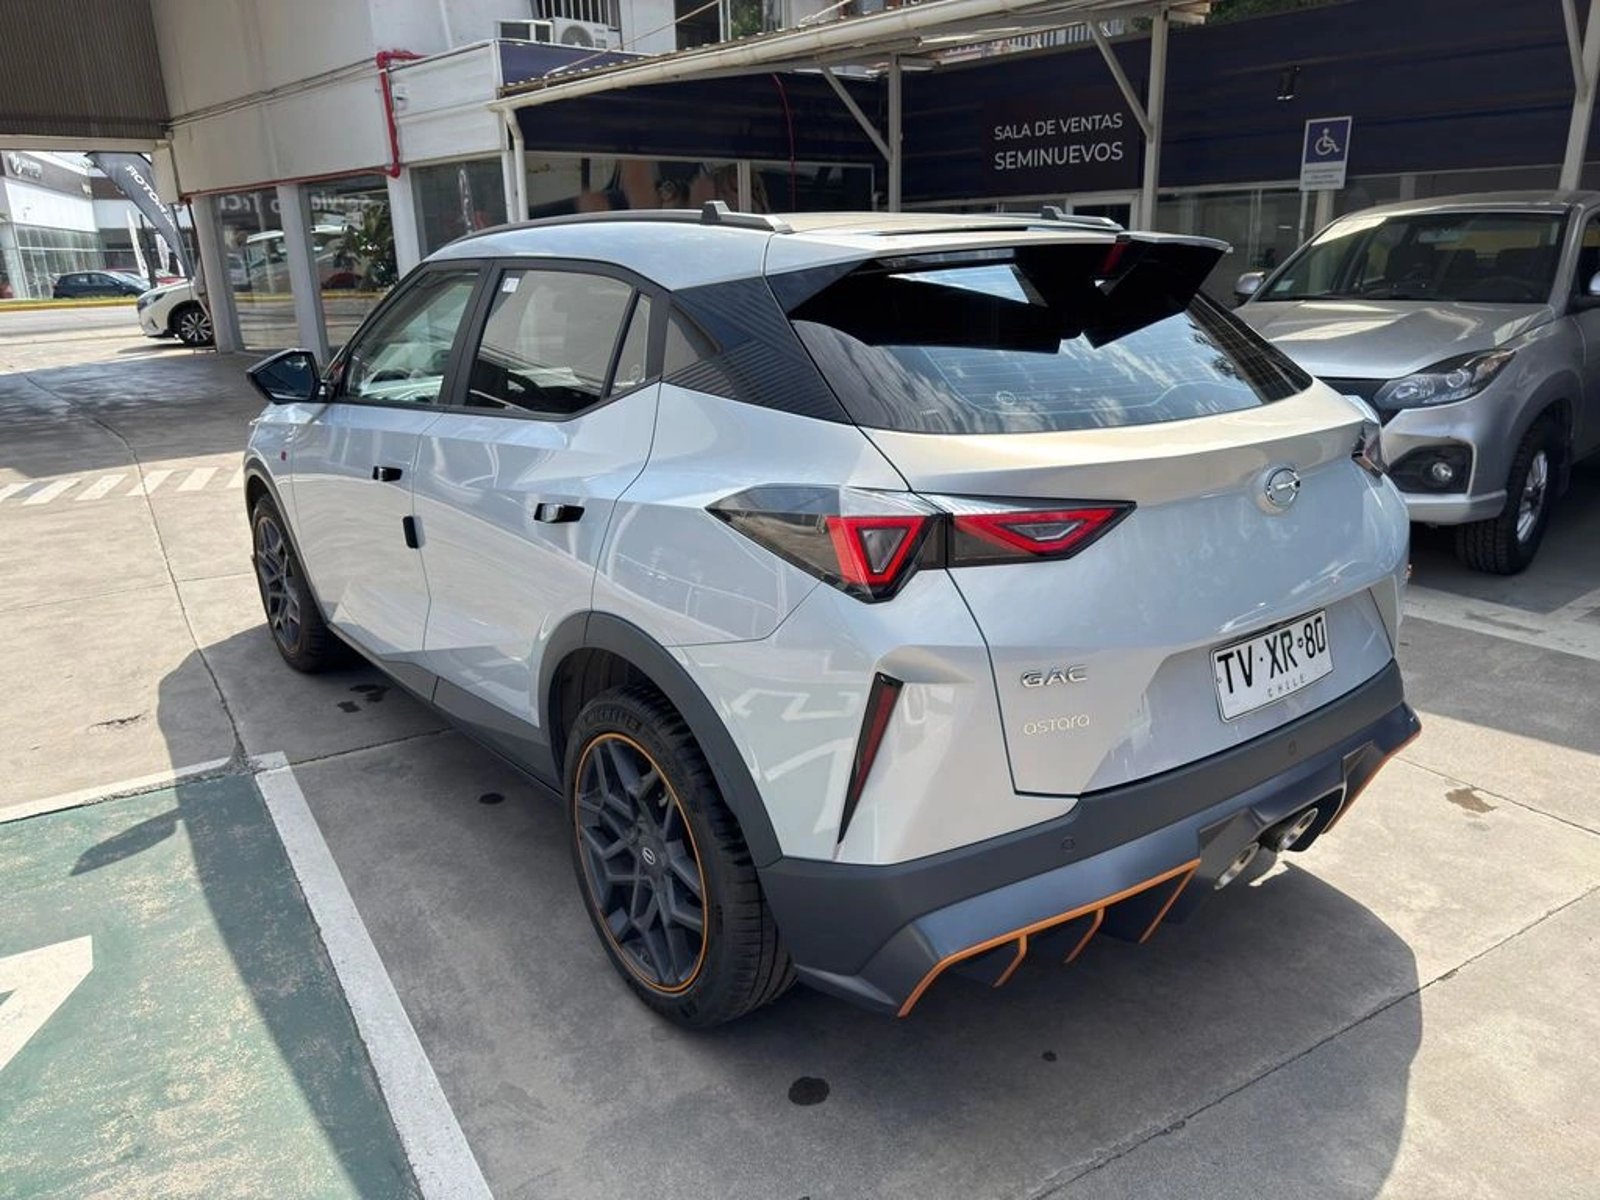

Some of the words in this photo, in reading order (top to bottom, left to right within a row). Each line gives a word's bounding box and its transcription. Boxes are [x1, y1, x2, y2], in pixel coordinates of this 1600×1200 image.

[994, 124, 1031, 140] SALA
[1035, 120, 1056, 136] DE
[1060, 112, 1123, 134] VENTAS
[994, 142, 1123, 170] SEMINUEVOS
[1021, 664, 1089, 687] GAC
[1267, 674, 1305, 697] CHILE
[1024, 714, 1090, 735] astara
